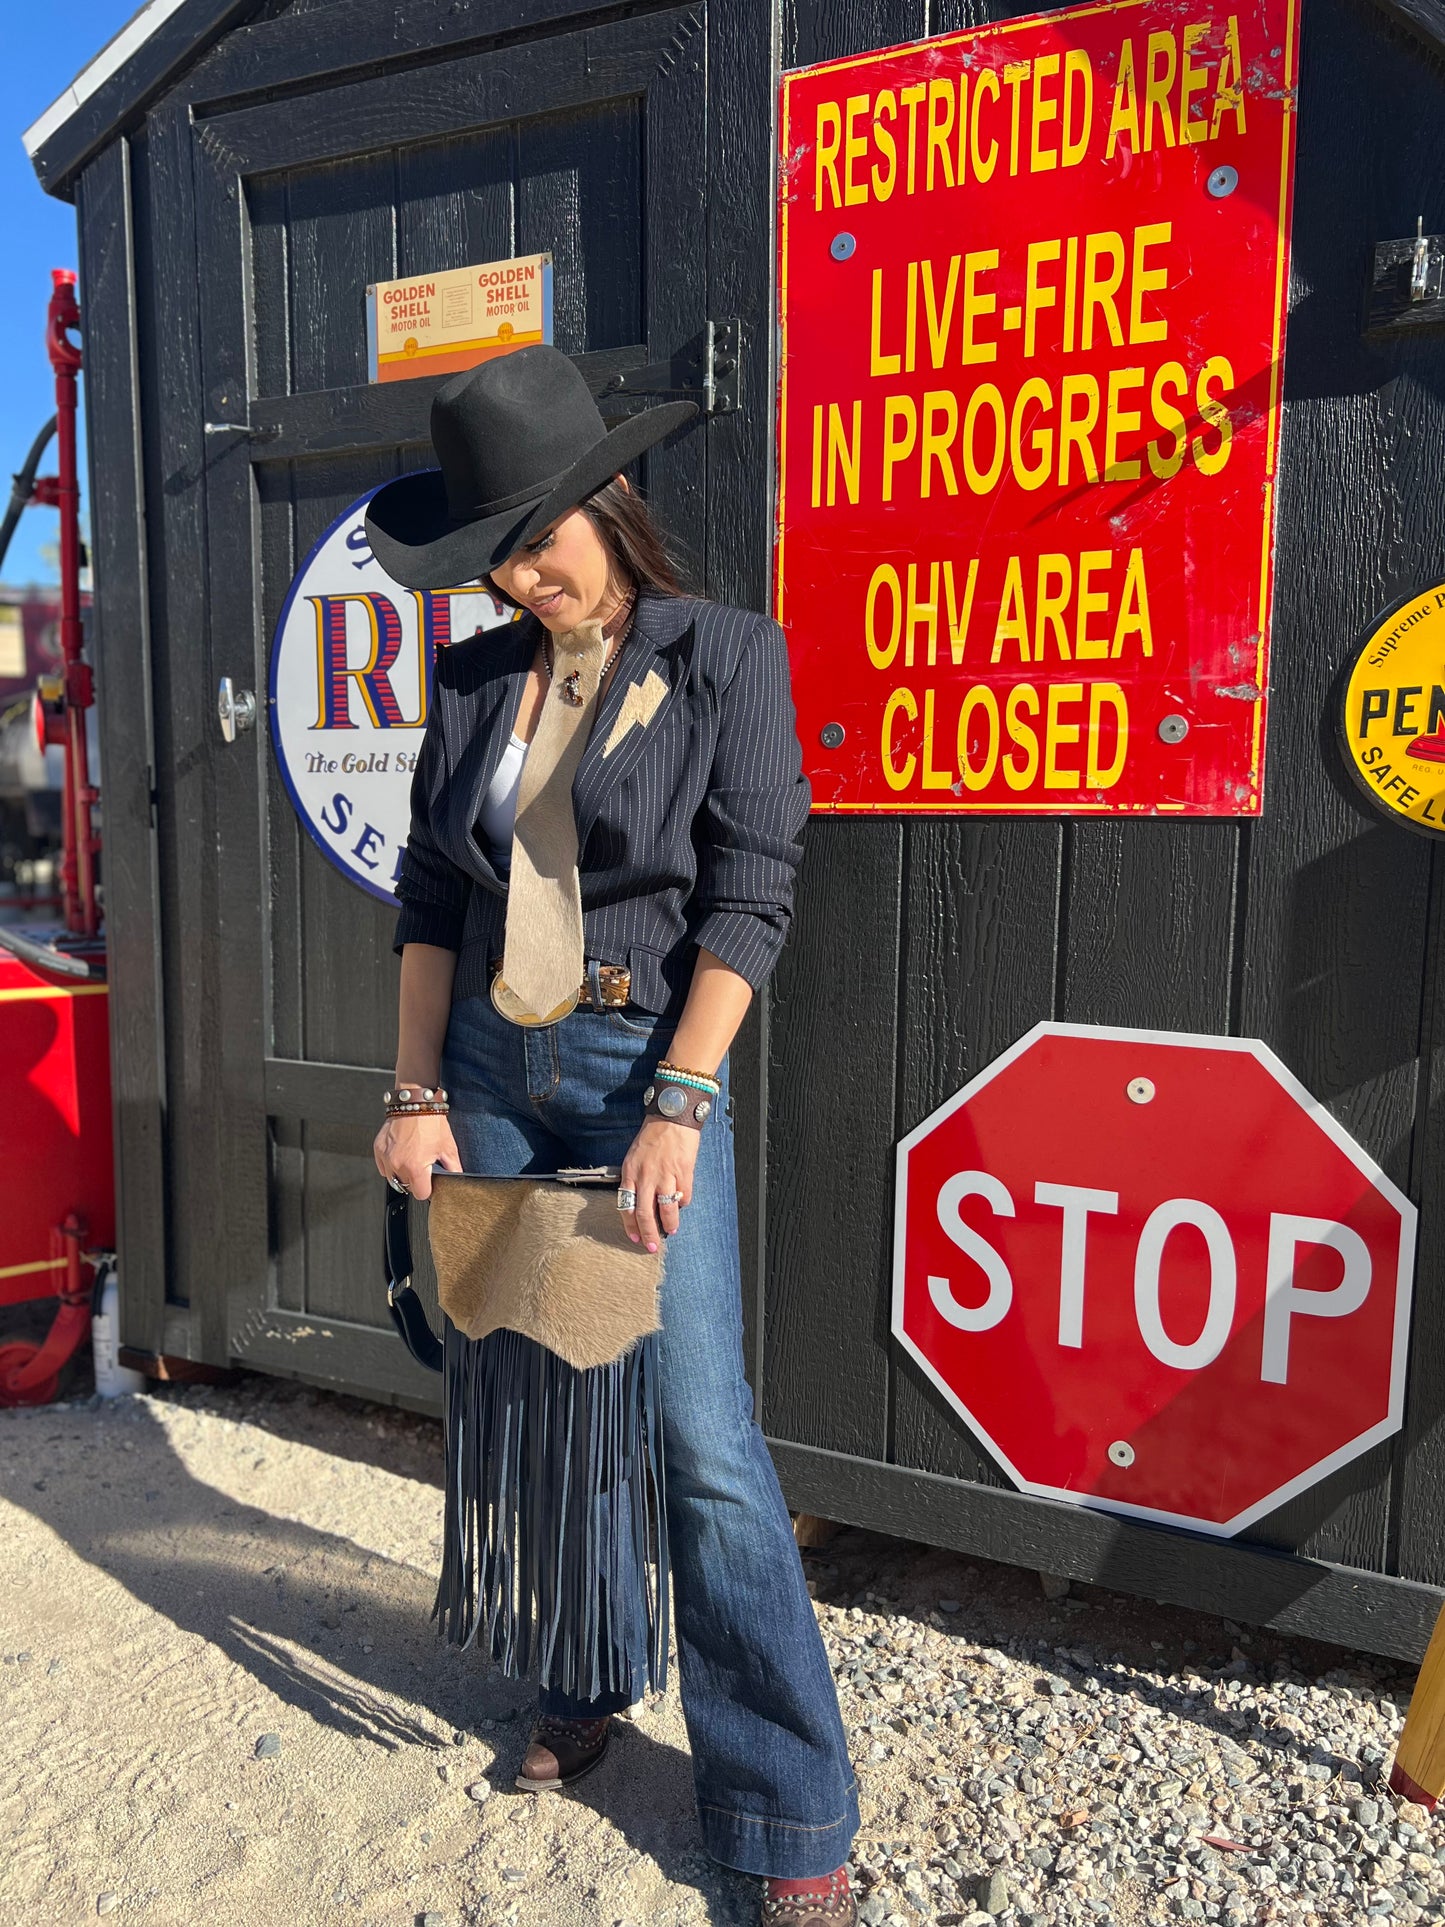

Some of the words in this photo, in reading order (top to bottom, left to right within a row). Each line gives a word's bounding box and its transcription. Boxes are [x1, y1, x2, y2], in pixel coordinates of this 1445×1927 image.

[815, 49, 1094, 211] RESTRICTED
[1105, 15, 1247, 160] AREA
[383, 283, 436, 305] GOLDEN
[391, 301, 430, 320] SHELL
[478, 265, 535, 288] GOLDEN
[486, 284, 530, 303] SHELL
[486, 303, 515, 317] MOTOR
[517, 301, 530, 312] OIL
[870, 222, 1172, 377] LIVE-FIRE
[391, 319, 417, 333] MOTOR
[419, 317, 431, 329] OIL
[811, 400, 862, 508] IN
[882, 355, 1235, 502] PROGRESS
[865, 558, 980, 670] OHV
[990, 547, 1154, 665] AREA
[1367, 605, 1432, 669] Supreme
[303, 585, 525, 730] RE
[305, 751, 338, 774] The
[341, 752, 390, 774] Gold
[881, 682, 1129, 791] CLOSED
[1361, 746, 1420, 809] SAFE
[1421, 798, 1445, 825] L
[927, 1170, 1373, 1385] STOP
